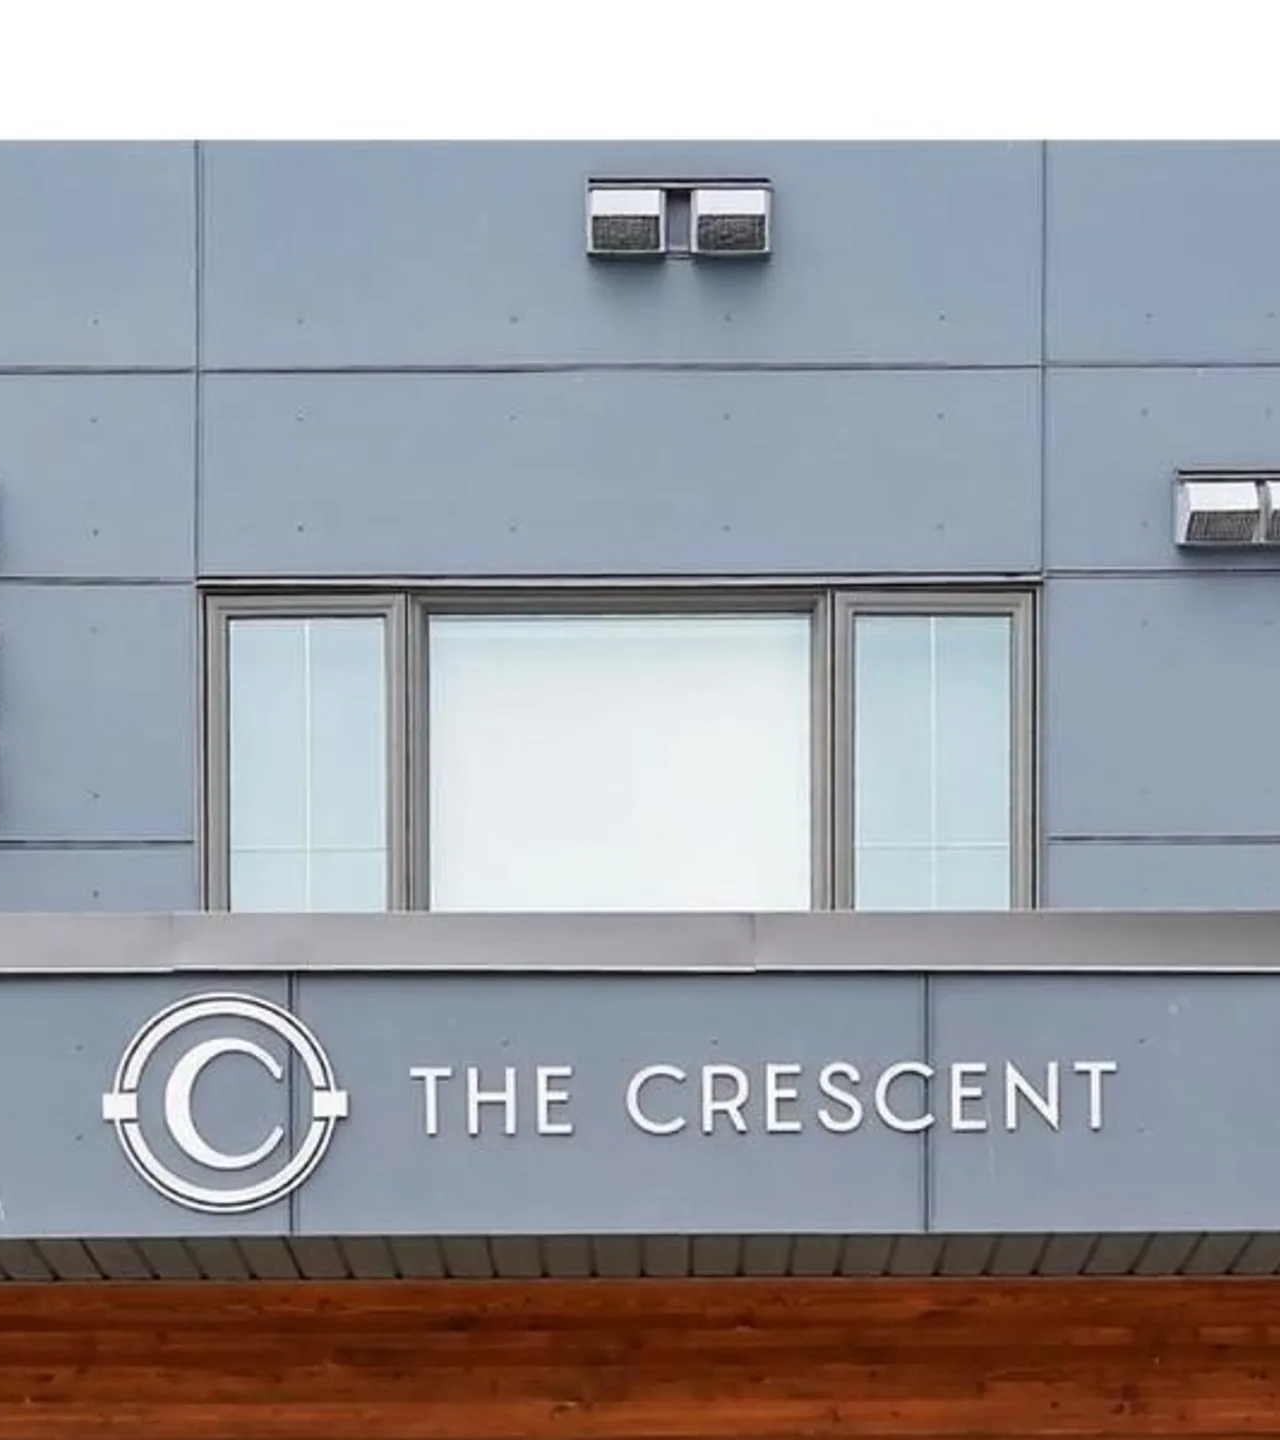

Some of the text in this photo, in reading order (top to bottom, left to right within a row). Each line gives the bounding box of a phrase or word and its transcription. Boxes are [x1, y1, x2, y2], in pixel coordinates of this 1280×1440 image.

[163, 1036, 286, 1170] C
[409, 1060, 1117, 1137] THE CRESCENT
